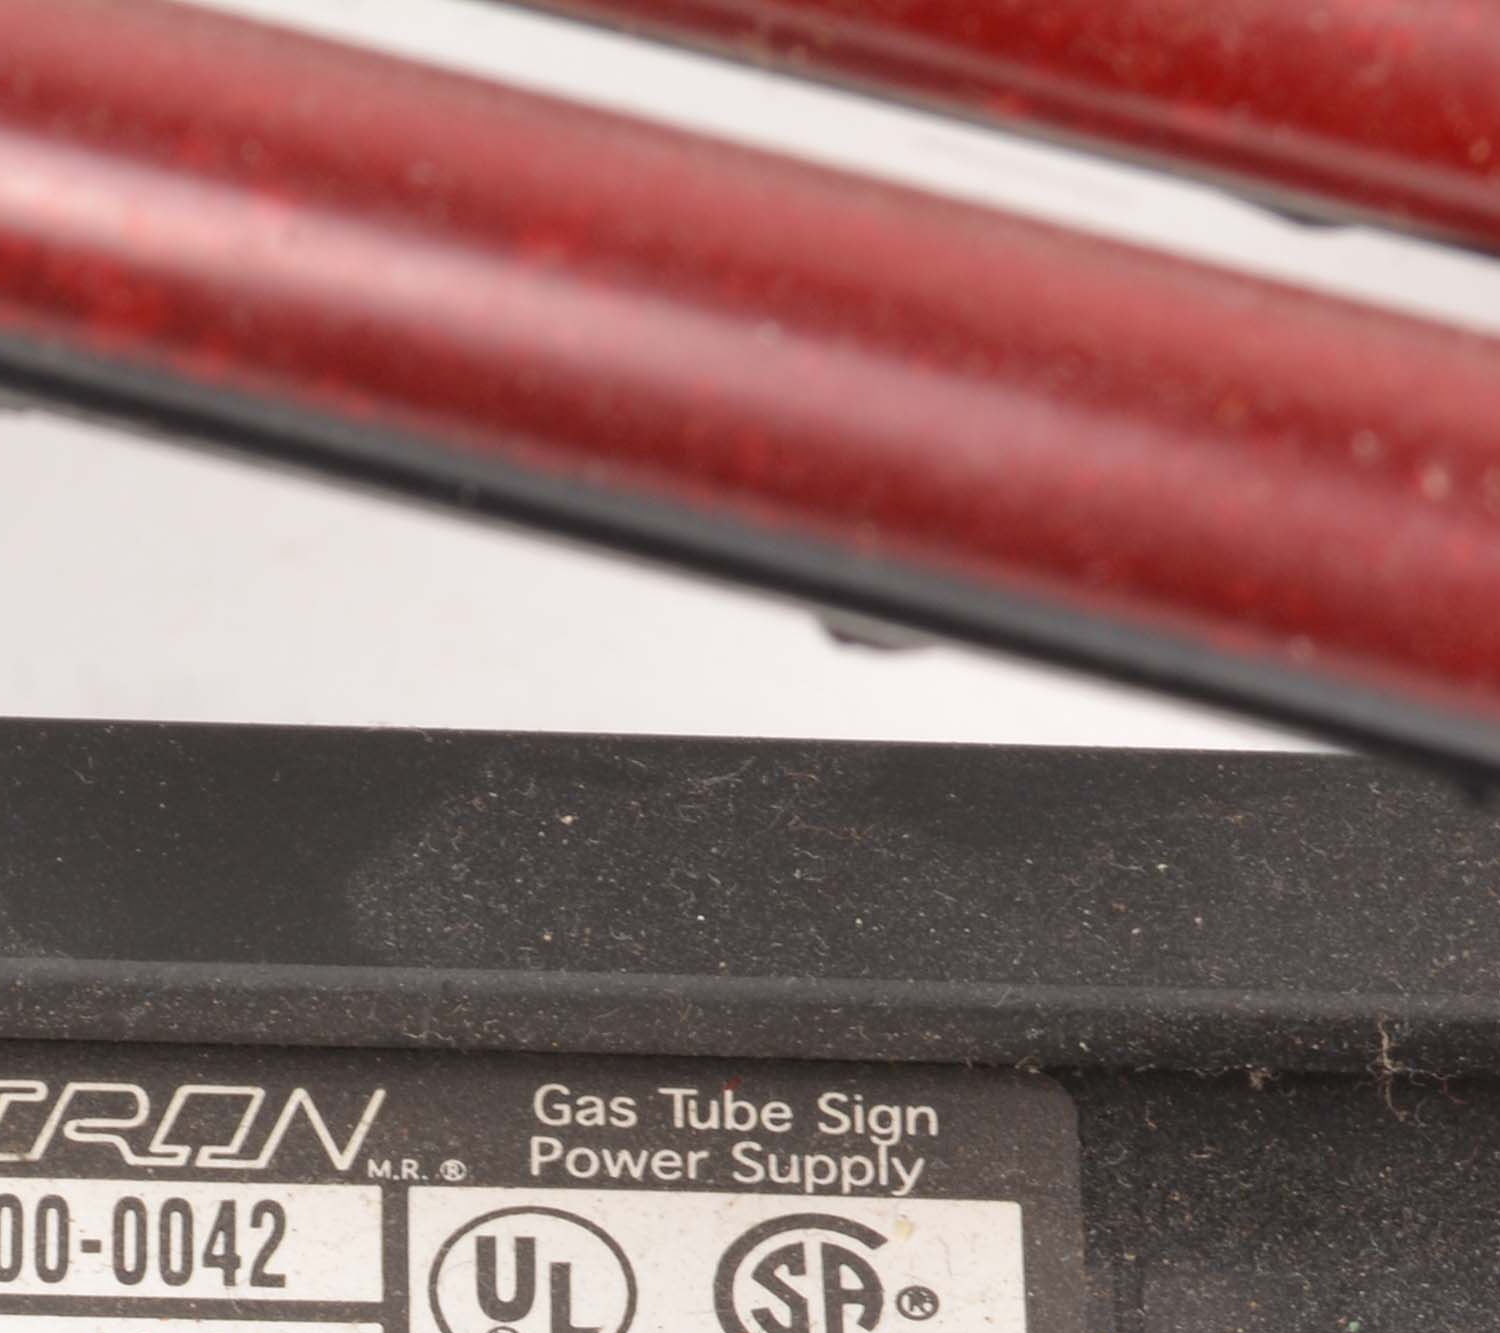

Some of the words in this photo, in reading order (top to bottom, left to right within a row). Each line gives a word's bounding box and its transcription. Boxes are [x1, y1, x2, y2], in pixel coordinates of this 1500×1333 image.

[532, 1083, 637, 1128] Gas
[657, 1086, 794, 1132] Tube
[817, 1091, 940, 1146] Sign
[529, 1136, 708, 1181] Power
[731, 1140, 925, 1196] Supply
